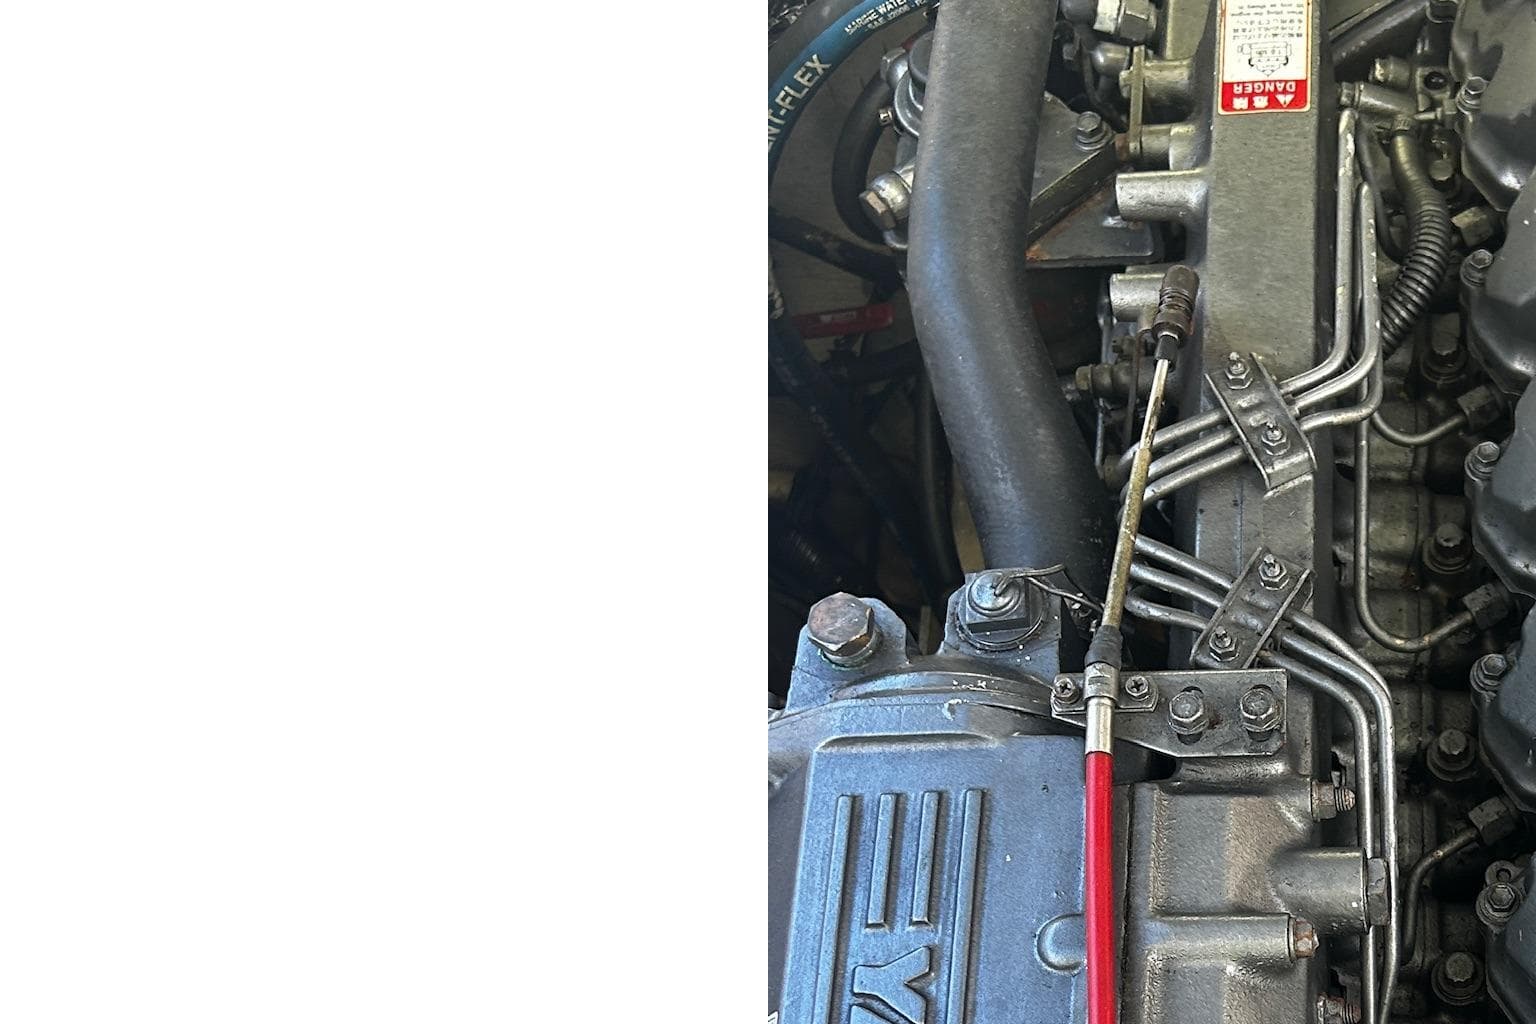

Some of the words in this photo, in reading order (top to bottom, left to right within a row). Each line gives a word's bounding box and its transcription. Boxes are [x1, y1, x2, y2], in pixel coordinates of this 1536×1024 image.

[876, 0, 907, 15] WATE
[1233, 81, 1297, 95] DANGER
[768, 54, 833, 152] NT-FLEX
